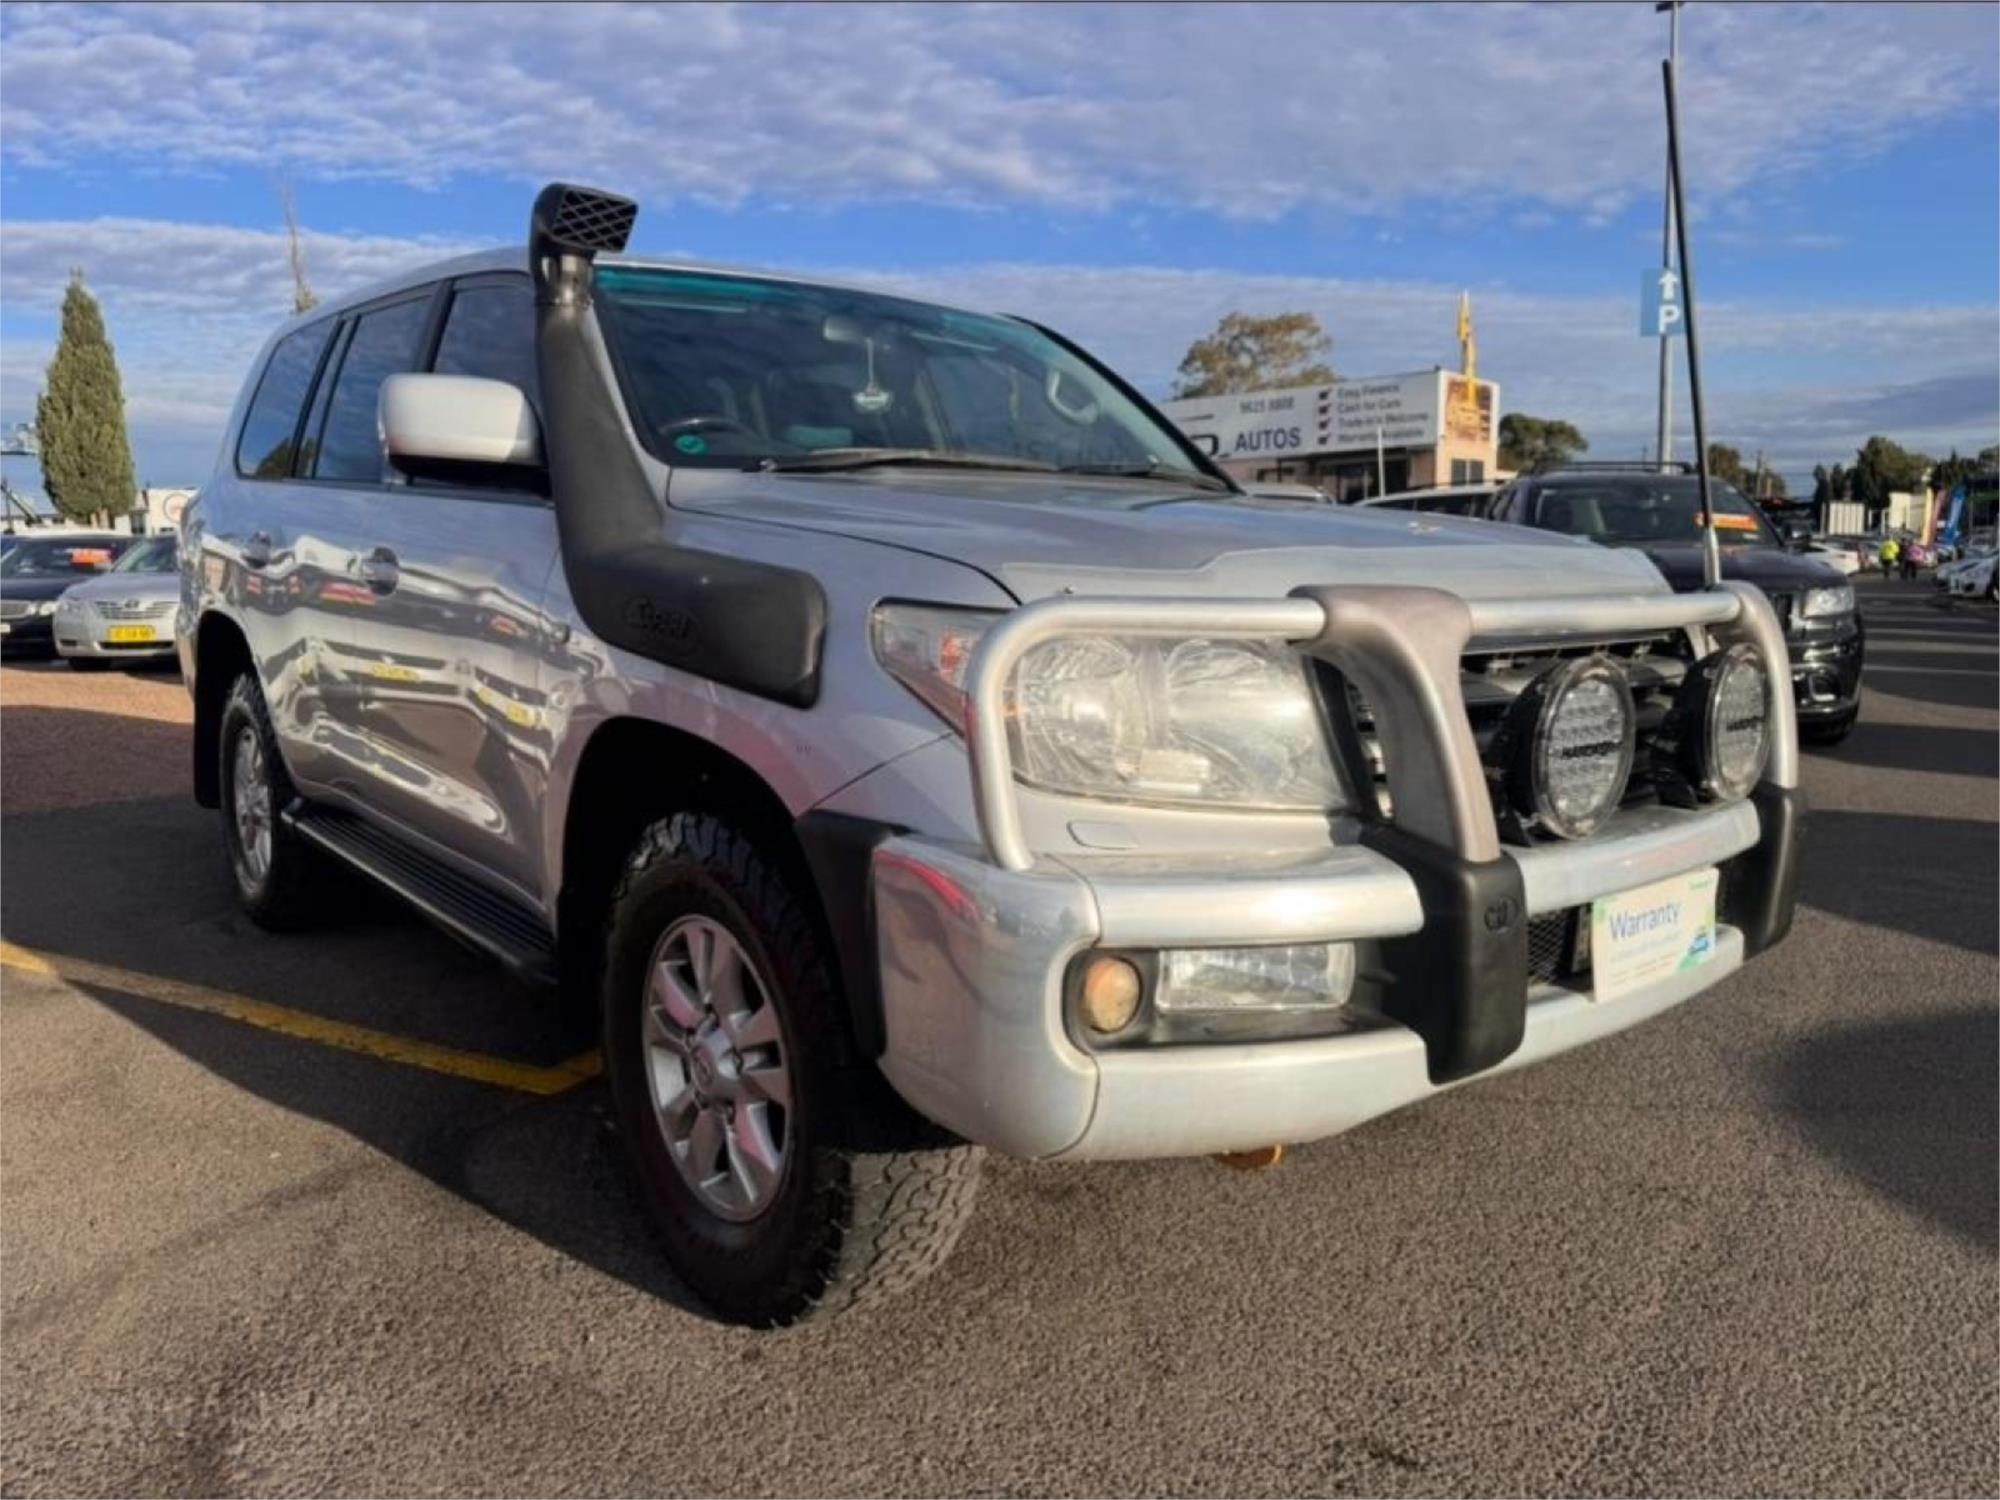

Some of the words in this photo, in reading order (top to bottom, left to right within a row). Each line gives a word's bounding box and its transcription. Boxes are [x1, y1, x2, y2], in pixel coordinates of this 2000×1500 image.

[1659, 305, 1679, 333] P
[1235, 427, 1301, 452] AUTOS
[1609, 903, 1679, 941] Warranty
